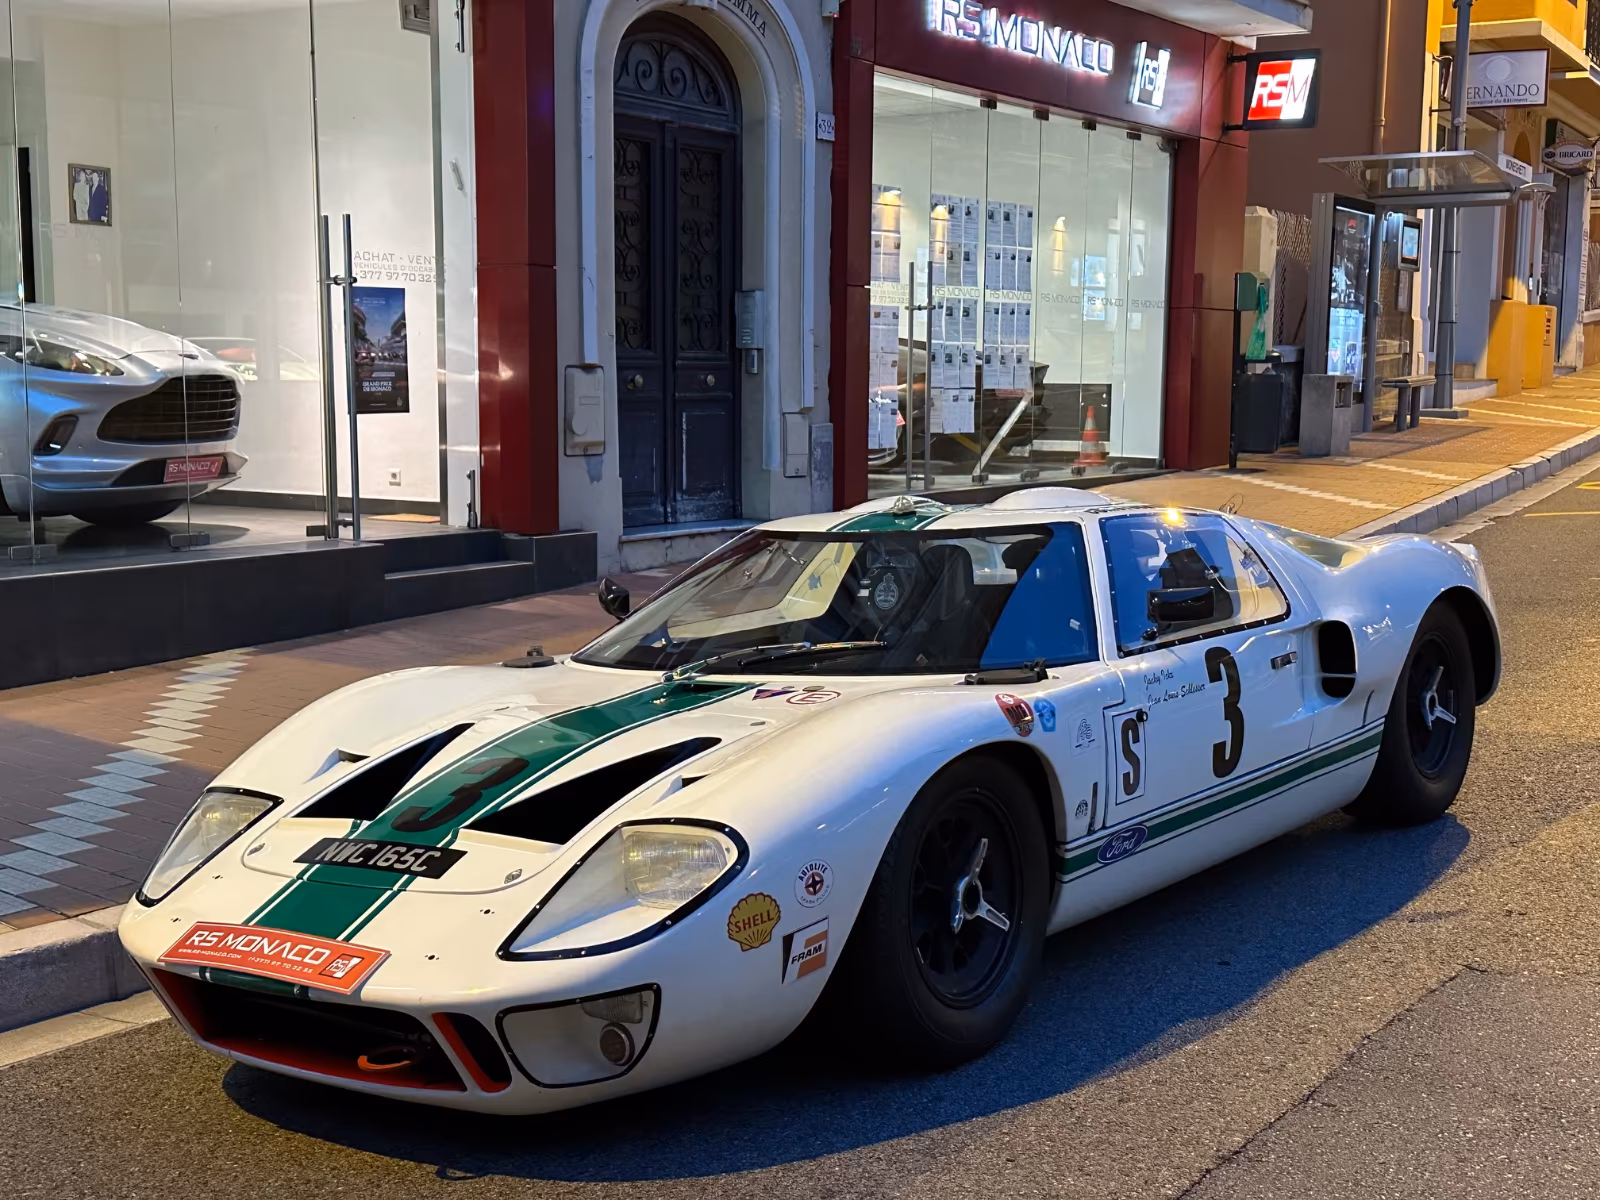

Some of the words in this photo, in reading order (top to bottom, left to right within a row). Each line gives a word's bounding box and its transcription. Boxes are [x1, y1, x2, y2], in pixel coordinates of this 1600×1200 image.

[727, 0, 766, 38] MMA
[927, 0, 985, 42] RS
[985, 7, 1114, 76] MONACO
[1250, 72, 1310, 108] RSM
[1466, 83, 1540, 100] ERNANDO
[820, 119, 832, 134] 32
[1559, 150, 1593, 158] BRICARD
[353, 251, 395, 263] ACHAT
[934, 286, 946, 296] RS
[947, 287, 980, 298] MONACO
[989, 290, 1000, 299] RS
[1001, 290, 1032, 301] MONACO
[1040, 293, 1050, 303] RS
[1051, 294, 1080, 304] MONACO
[1205, 646, 1245, 779] 3
[1120, 717, 1141, 796] S
[390, 757, 530, 833] 3
[315, 841, 378, 864] NWC
[367, 844, 442, 872] 165C
[1106, 831, 1139, 858] Ford
[798, 862, 829, 882] AUTOLITE
[734, 909, 775, 934] SHELL
[186, 931, 225, 947] RS
[218, 933, 332, 965] MONACO
[791, 943, 823, 965] FRAM
